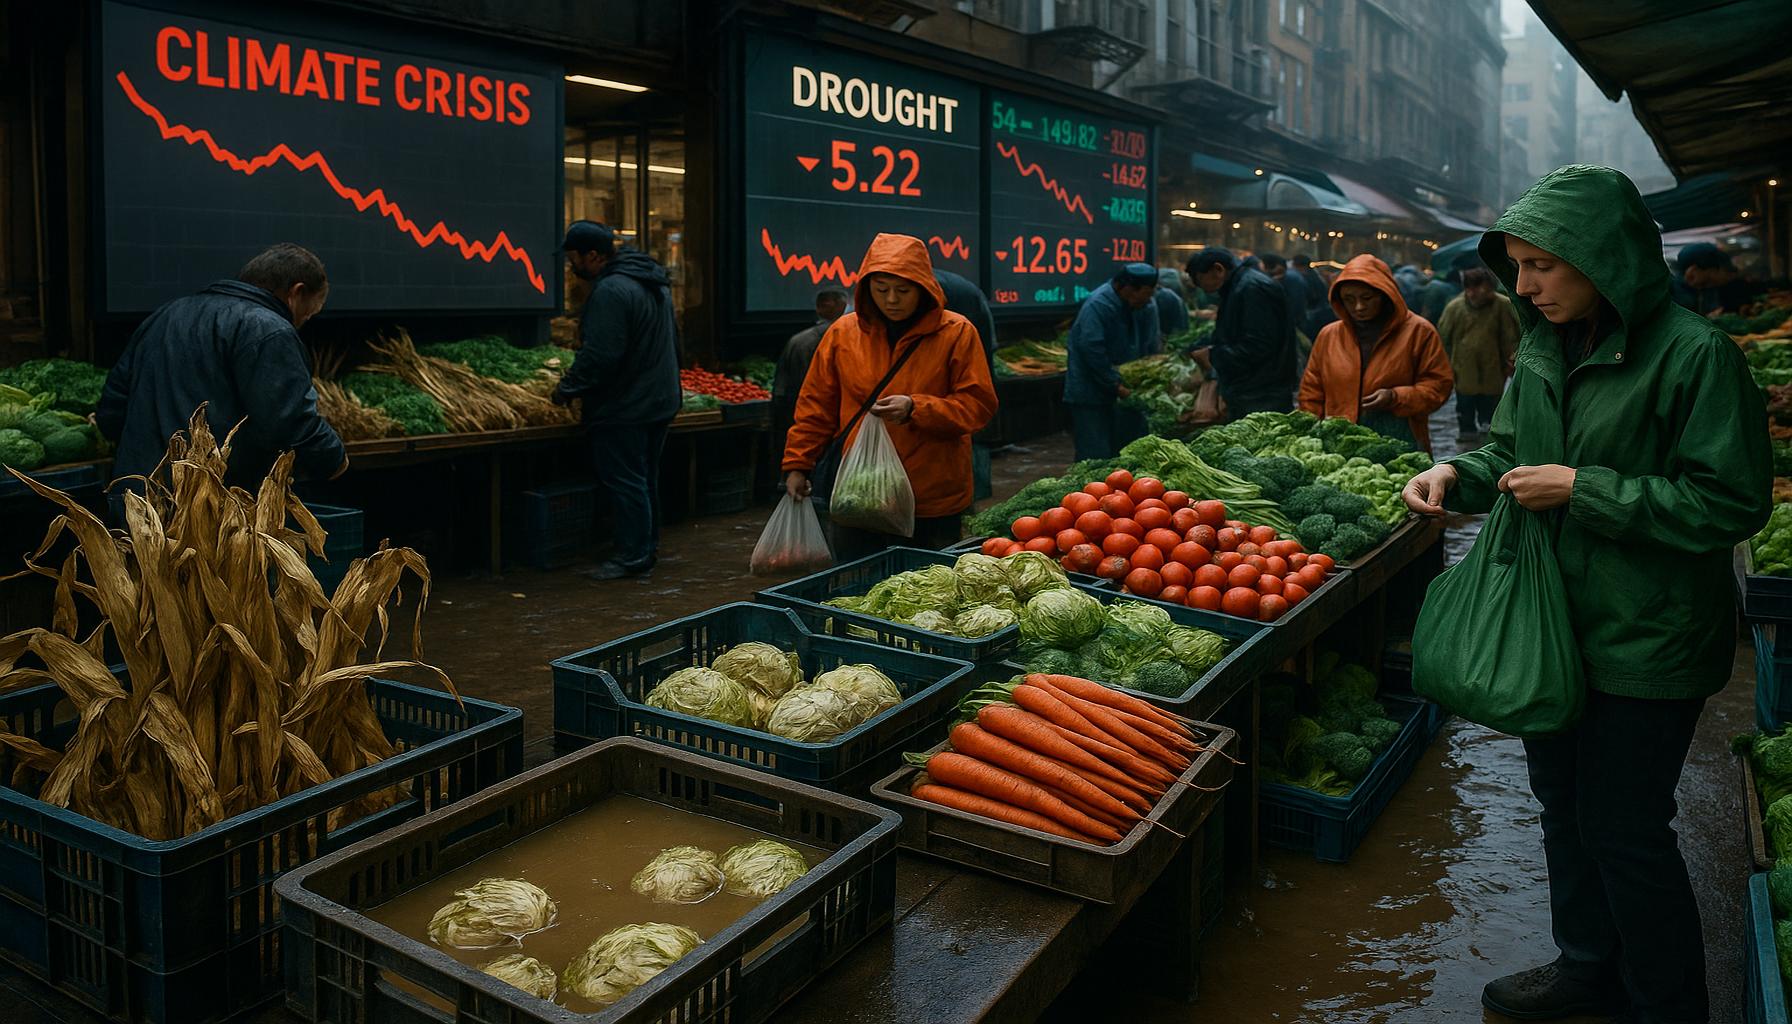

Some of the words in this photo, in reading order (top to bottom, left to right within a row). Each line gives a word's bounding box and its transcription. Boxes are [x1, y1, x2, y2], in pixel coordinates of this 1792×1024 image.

[155, 26, 381, 106] CLIMATE
[394, 63, 531, 126] CRISIS
[792, 67, 959, 132] DROUGHT
[831, 140, 922, 197] 5.22
[1012, 235, 1088, 274] 12.65
